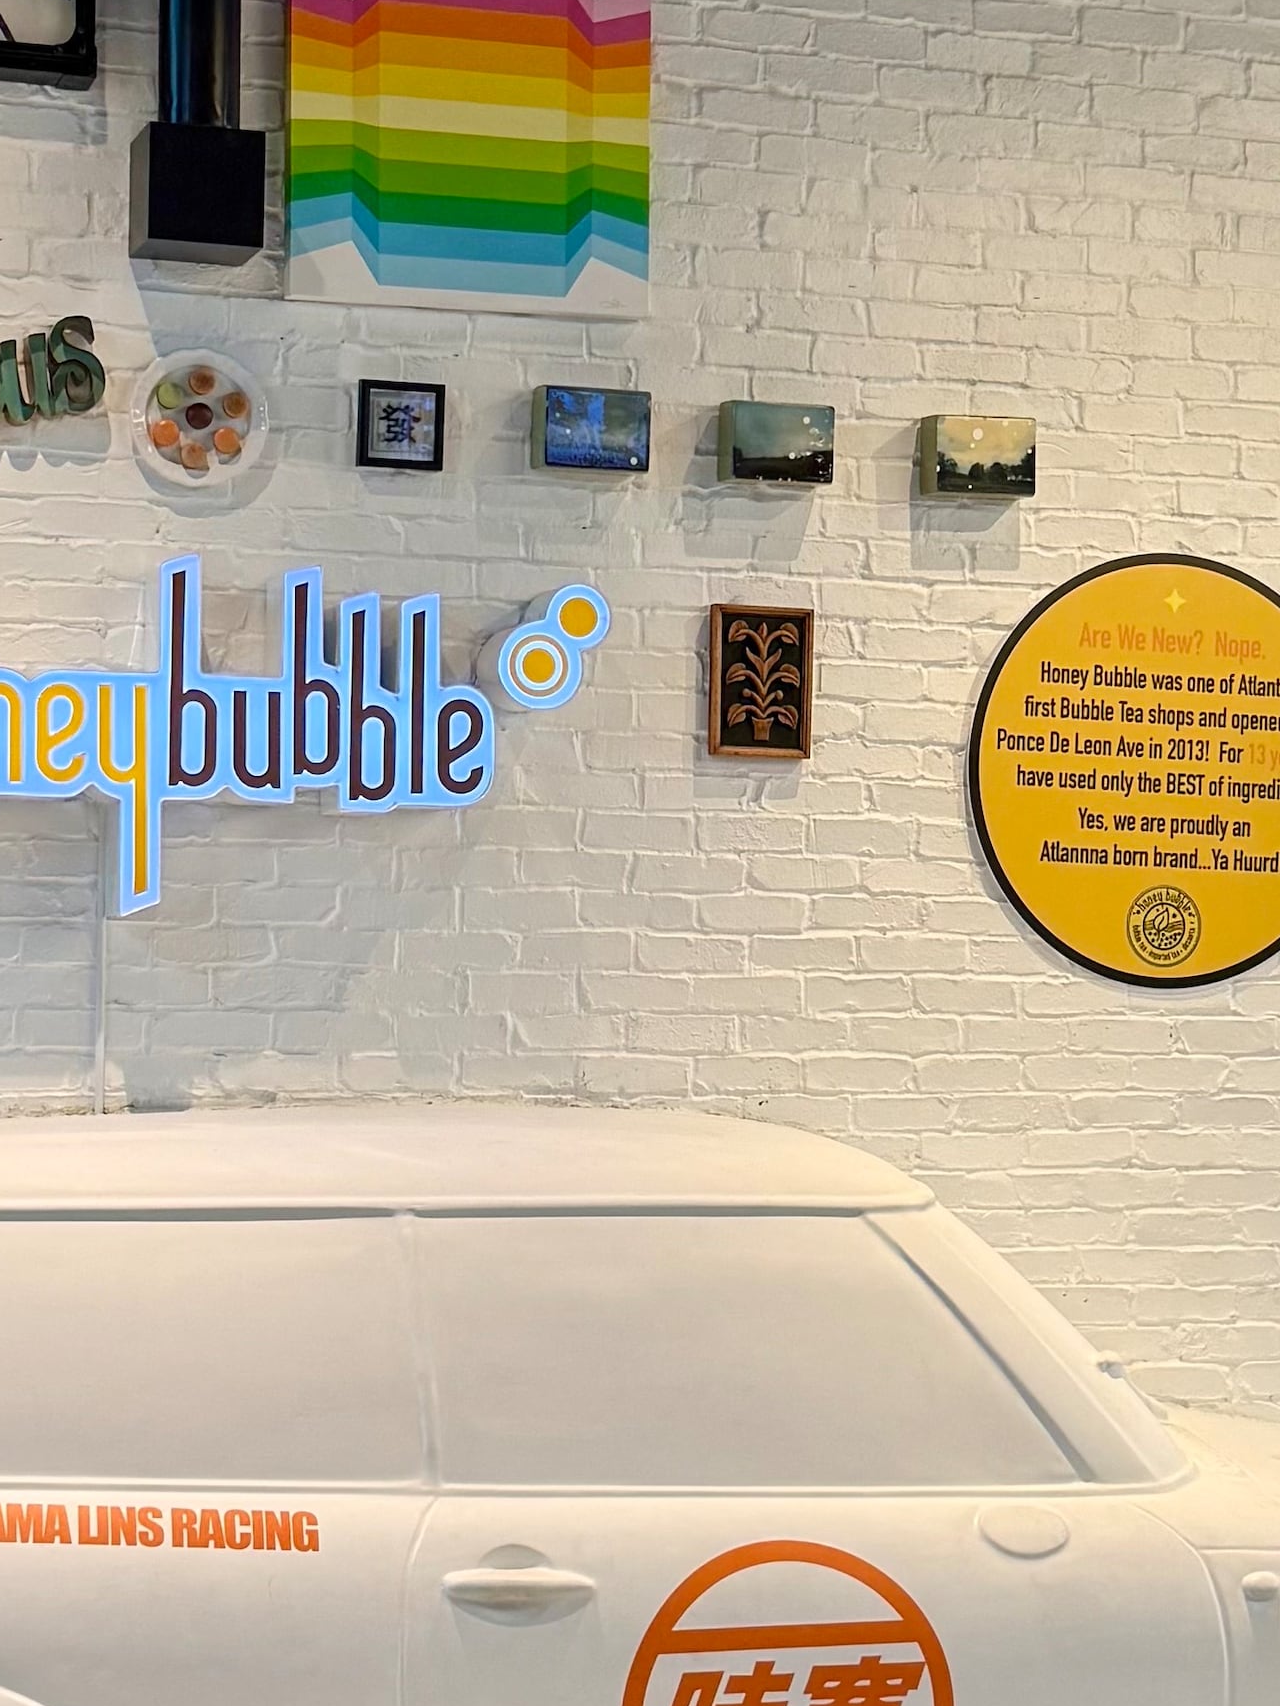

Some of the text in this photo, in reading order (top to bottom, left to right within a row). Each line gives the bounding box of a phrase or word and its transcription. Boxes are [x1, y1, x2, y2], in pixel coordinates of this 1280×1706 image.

[1079, 622, 1266, 664] Are We New? Nope.
[1041, 661, 1089, 691] Honey
[1094, 664, 1147, 689] Bubble
[1151, 674, 1182, 691] was
[1187, 677, 1214, 693] one
[1220, 674, 1235, 694] of
[1025, 695, 1056, 718] first
[1060, 697, 1114, 721] Bubble
[1118, 701, 1143, 723] Tea
[1148, 703, 1194, 731] shops
[1199, 707, 1227, 728] and
[997, 728, 1045, 752] Ponce
[1050, 731, 1069, 753] De
[1075, 732, 1111, 756] Leon
[1116, 735, 1144, 758] Ave
[1149, 737, 1162, 759] in
[1167, 738, 1209, 762] 2013!
[1219, 741, 1244, 763] For
[1249, 743, 1266, 764] 13
[1017, 764, 1054, 787] have
[1059, 768, 1096, 789] used
[1101, 770, 1134, 797] only
[1138, 771, 1161, 793] the
[1166, 772, 1205, 796] BEST
[1209, 776, 1224, 796] of
[1078, 807, 1250, 842] Yes, we are proudly an
[1040, 840, 1108, 864] Atlannna
[1113, 844, 1148, 867] born
[78, 1505, 164, 1547] LINS
[171, 1507, 319, 1552] RACING
